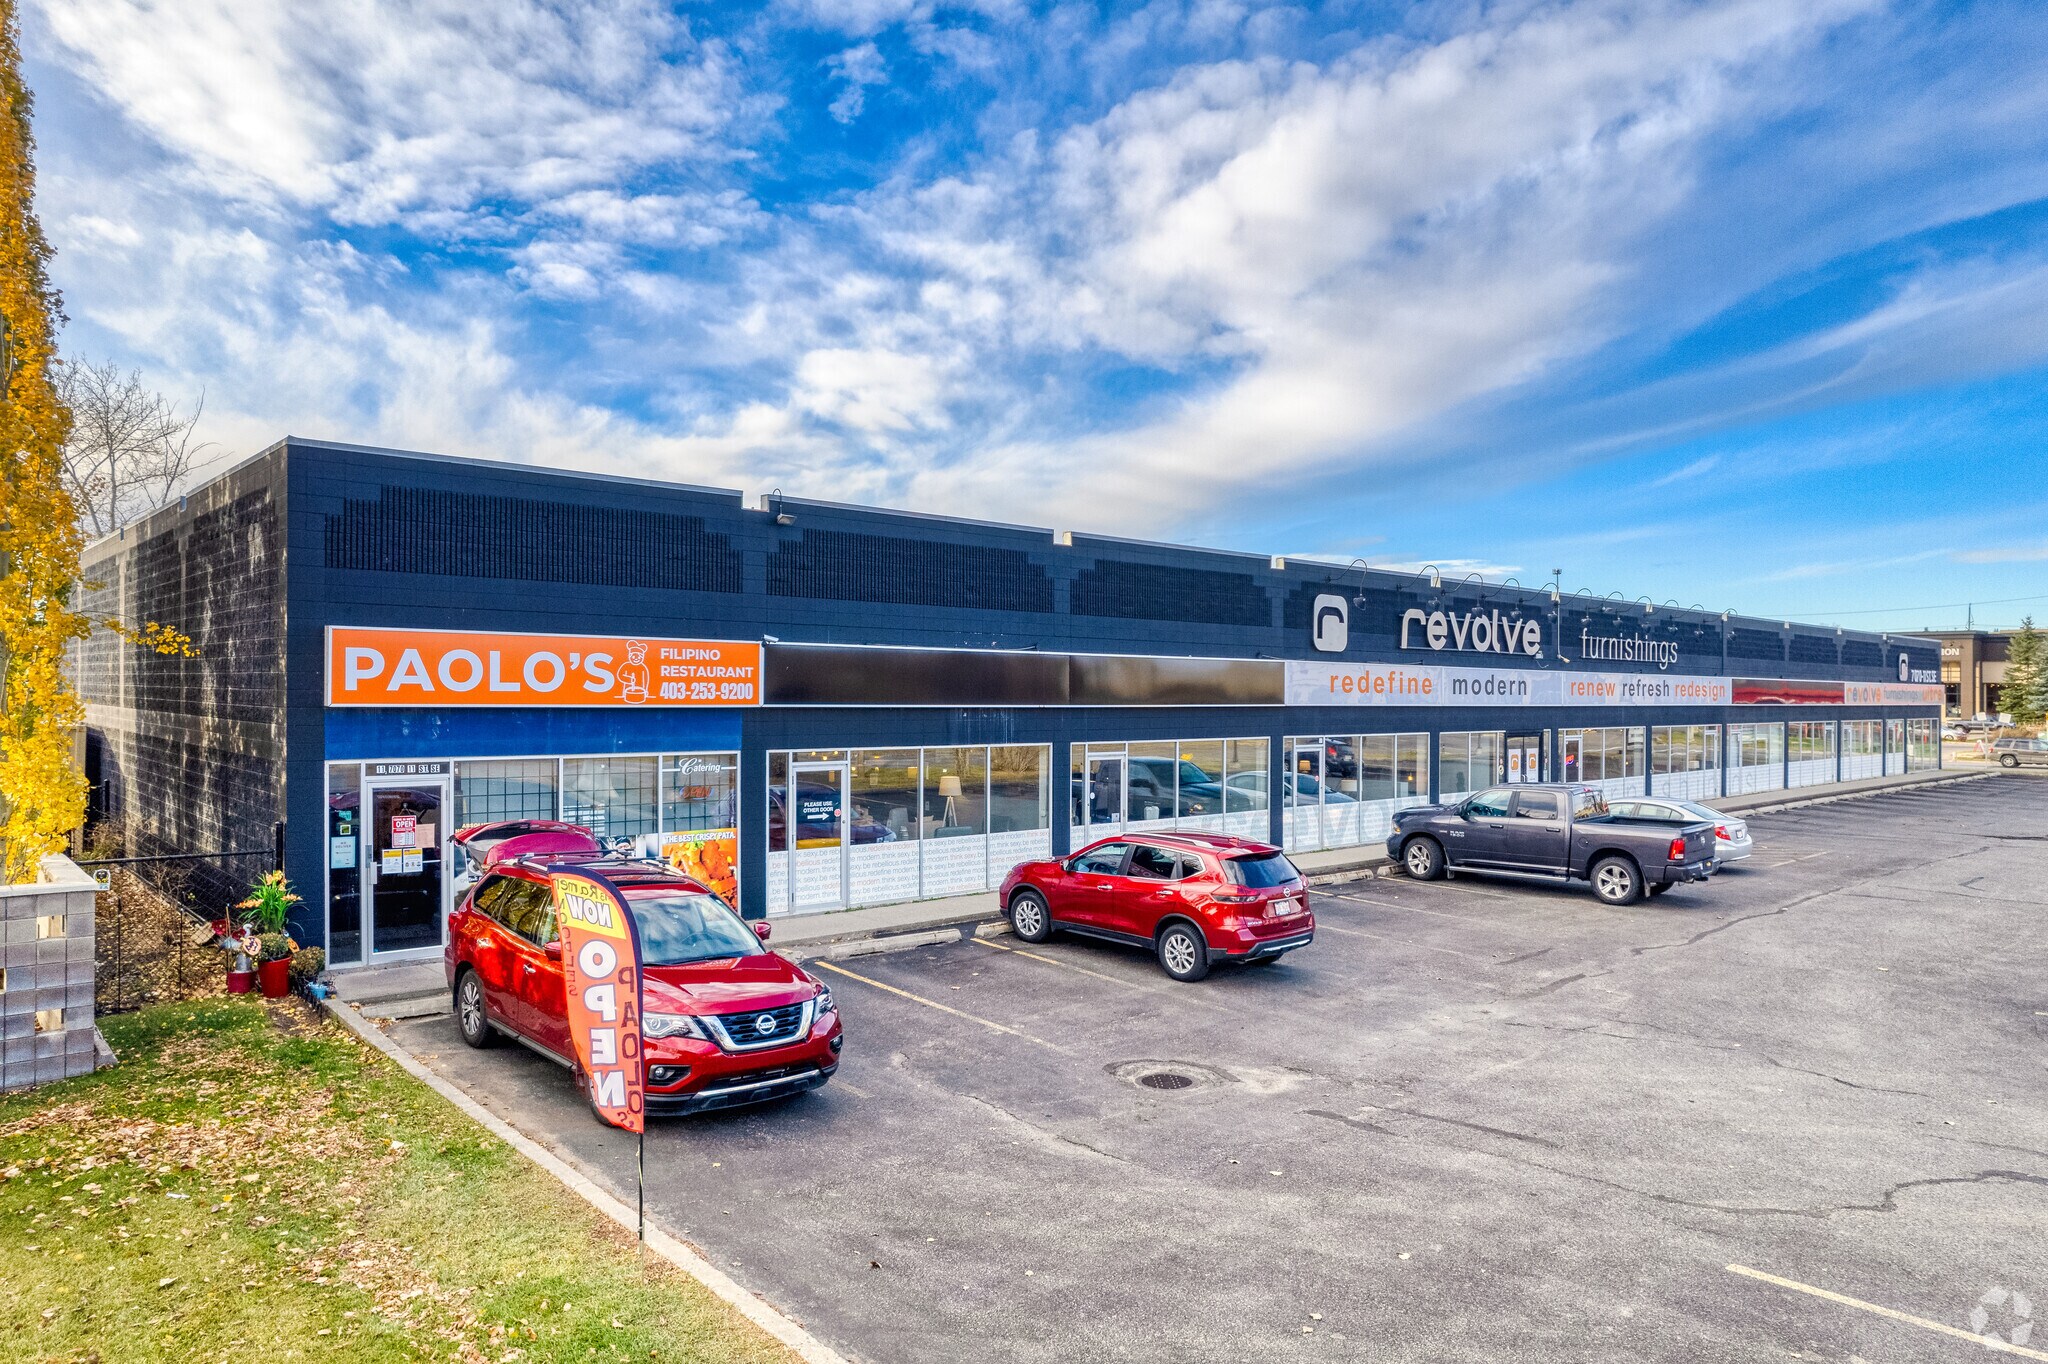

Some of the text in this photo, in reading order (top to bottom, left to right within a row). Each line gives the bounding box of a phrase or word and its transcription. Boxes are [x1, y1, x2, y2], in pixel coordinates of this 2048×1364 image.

[1401, 608, 1541, 656] revolve
[660, 647, 721, 661] FILIPINO
[1580, 627, 1678, 670] furnishings
[345, 646, 616, 693] PAOLO'S
[660, 665, 754, 679] RESTAURANT
[660, 682, 754, 700] 403-253-9200
[1330, 671, 1528, 696] redefine modern
[1570, 679, 1726, 701] renew refresh redesign
[388, 765, 405, 774] 7070
[430, 763, 441, 773] SE
[678, 758, 721, 775] Catering
[395, 820, 414, 828] OPEN
[666, 835, 679, 843] THE
